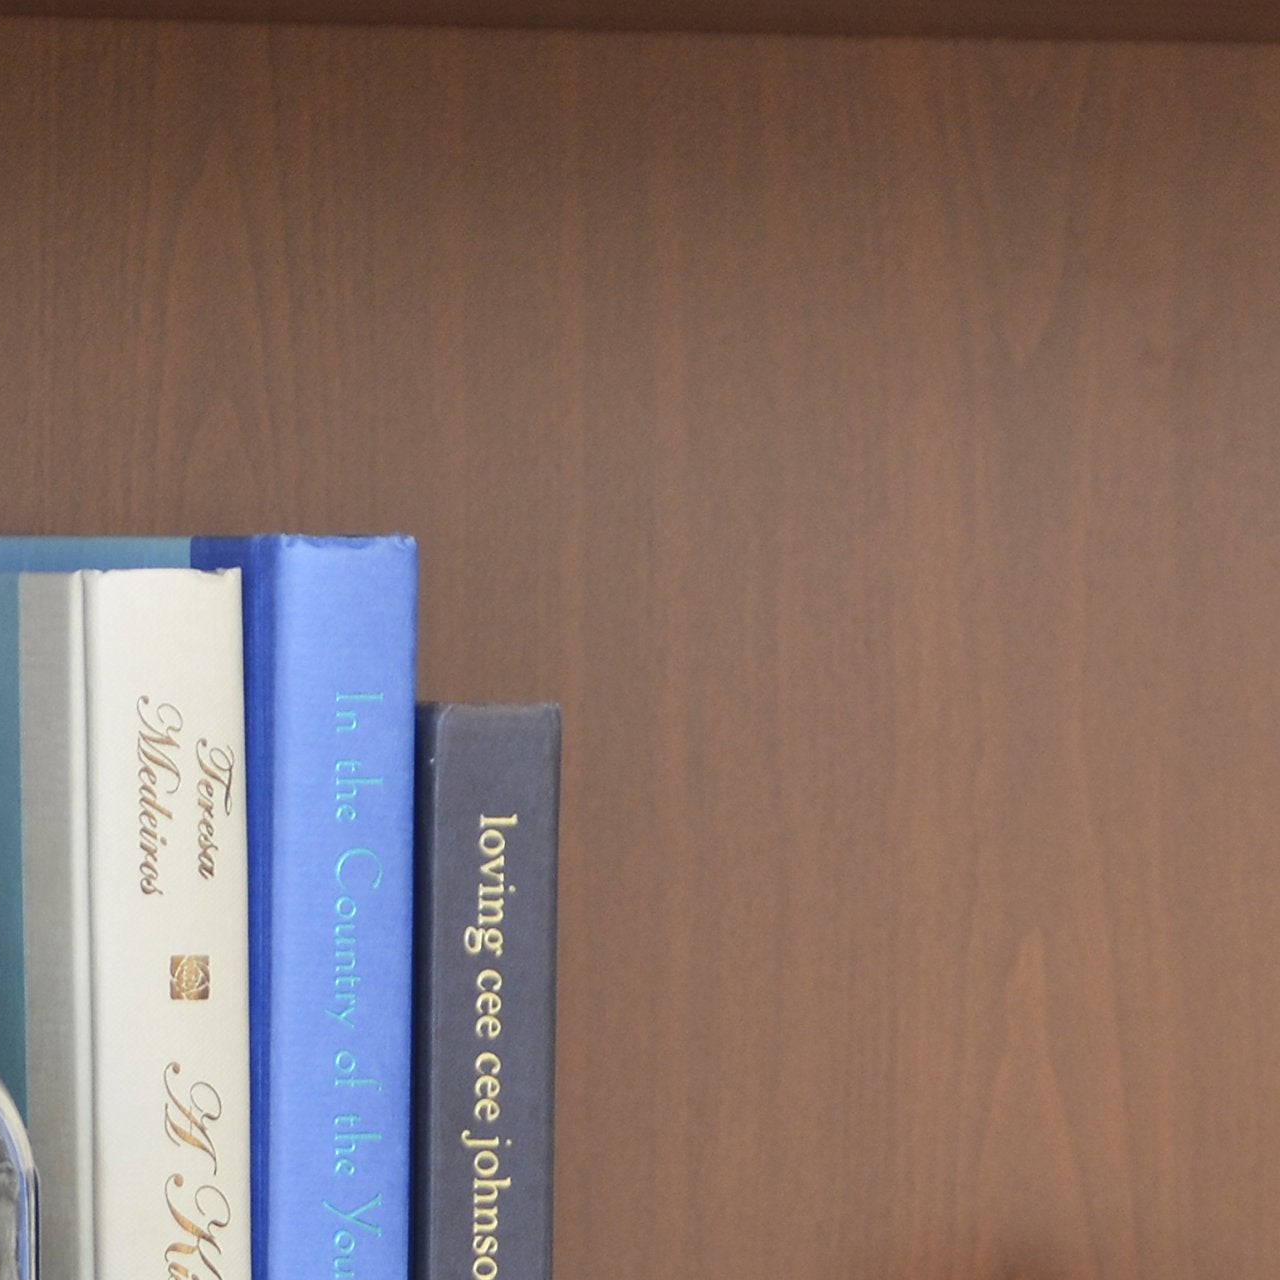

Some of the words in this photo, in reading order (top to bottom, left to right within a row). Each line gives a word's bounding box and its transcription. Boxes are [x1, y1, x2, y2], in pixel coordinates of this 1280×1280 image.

[335, 691, 384, 733] In
[136, 695, 183, 895] Medeiros
[195, 738, 235, 880] Teresa
[335, 760, 384, 823] the
[463, 813, 519, 958] loving
[323, 848, 383, 1029] Country
[475, 968, 503, 1040] cee
[333, 1049, 383, 1092] of
[473, 1051, 502, 1122] cee
[163, 1061, 222, 1176] A
[333, 1113, 382, 1177] the
